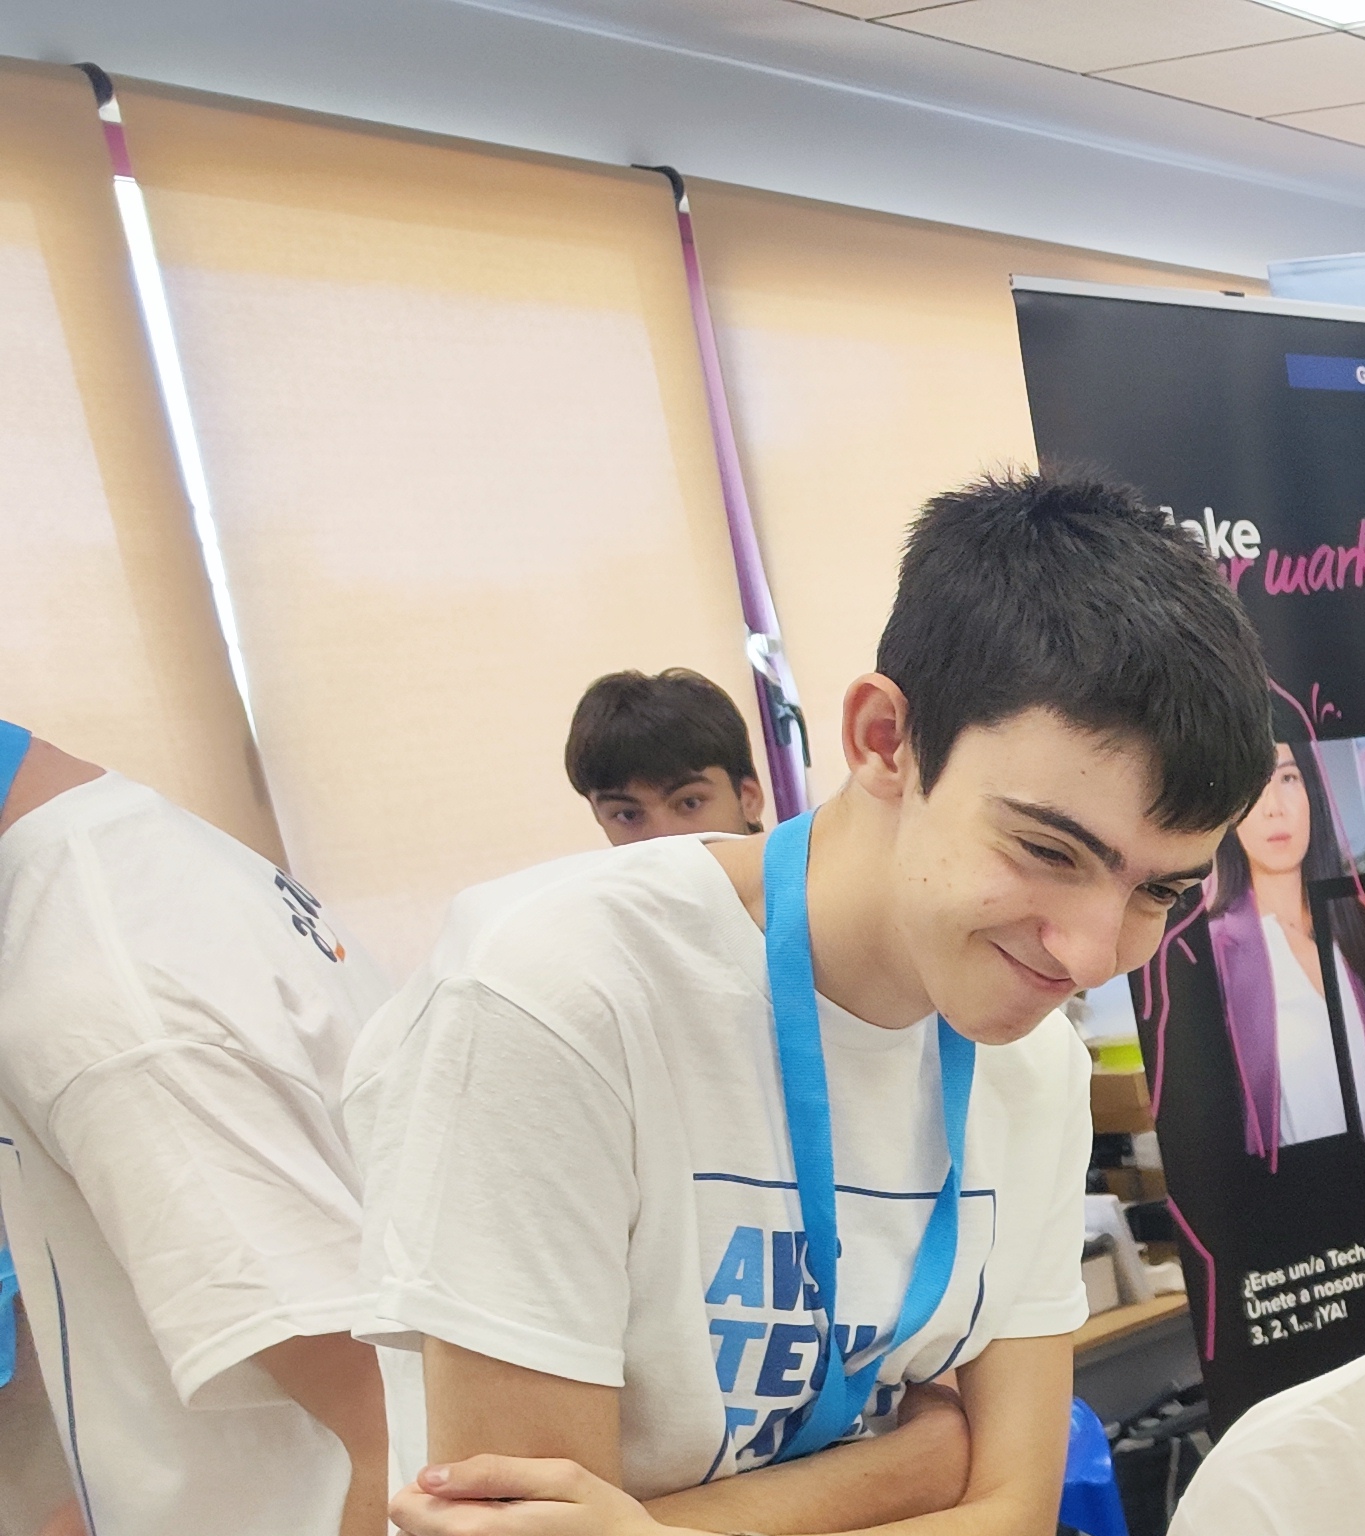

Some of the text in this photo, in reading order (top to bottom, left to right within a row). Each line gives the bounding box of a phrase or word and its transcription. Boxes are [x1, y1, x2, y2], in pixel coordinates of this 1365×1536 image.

[1159, 506, 1261, 559] ake
[705, 1226, 842, 1312] AW
[1244, 1269, 1287, 1298] ¿Eres
[1288, 1255, 1326, 1281] un/a
[1299, 1287, 1311, 1303] a
[1250, 1325, 1270, 1347] 3,
[1271, 1319, 1290, 1340] 2,
[1315, 1299, 1349, 1331] ¡YA!
